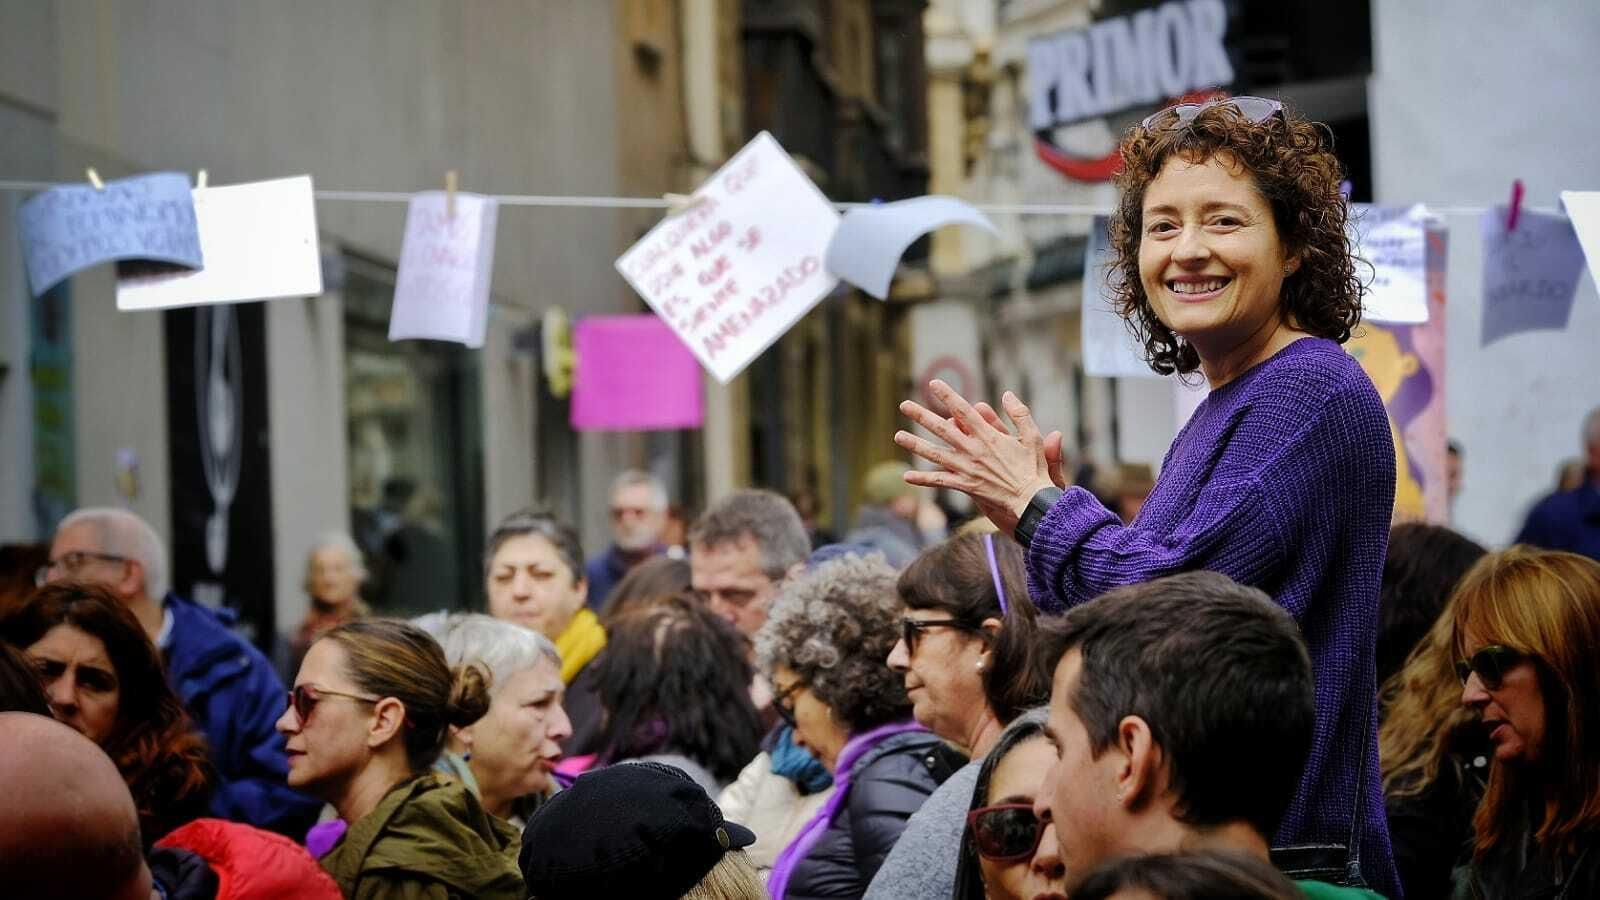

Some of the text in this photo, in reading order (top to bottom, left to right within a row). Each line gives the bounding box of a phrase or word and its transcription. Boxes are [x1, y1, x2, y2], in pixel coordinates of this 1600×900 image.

[1029, 0, 1234, 128] PRIMOR
[690, 221, 733, 258] ALGO
[696, 255, 731, 285] QUE
[702, 255, 818, 358] AMENAZADO
